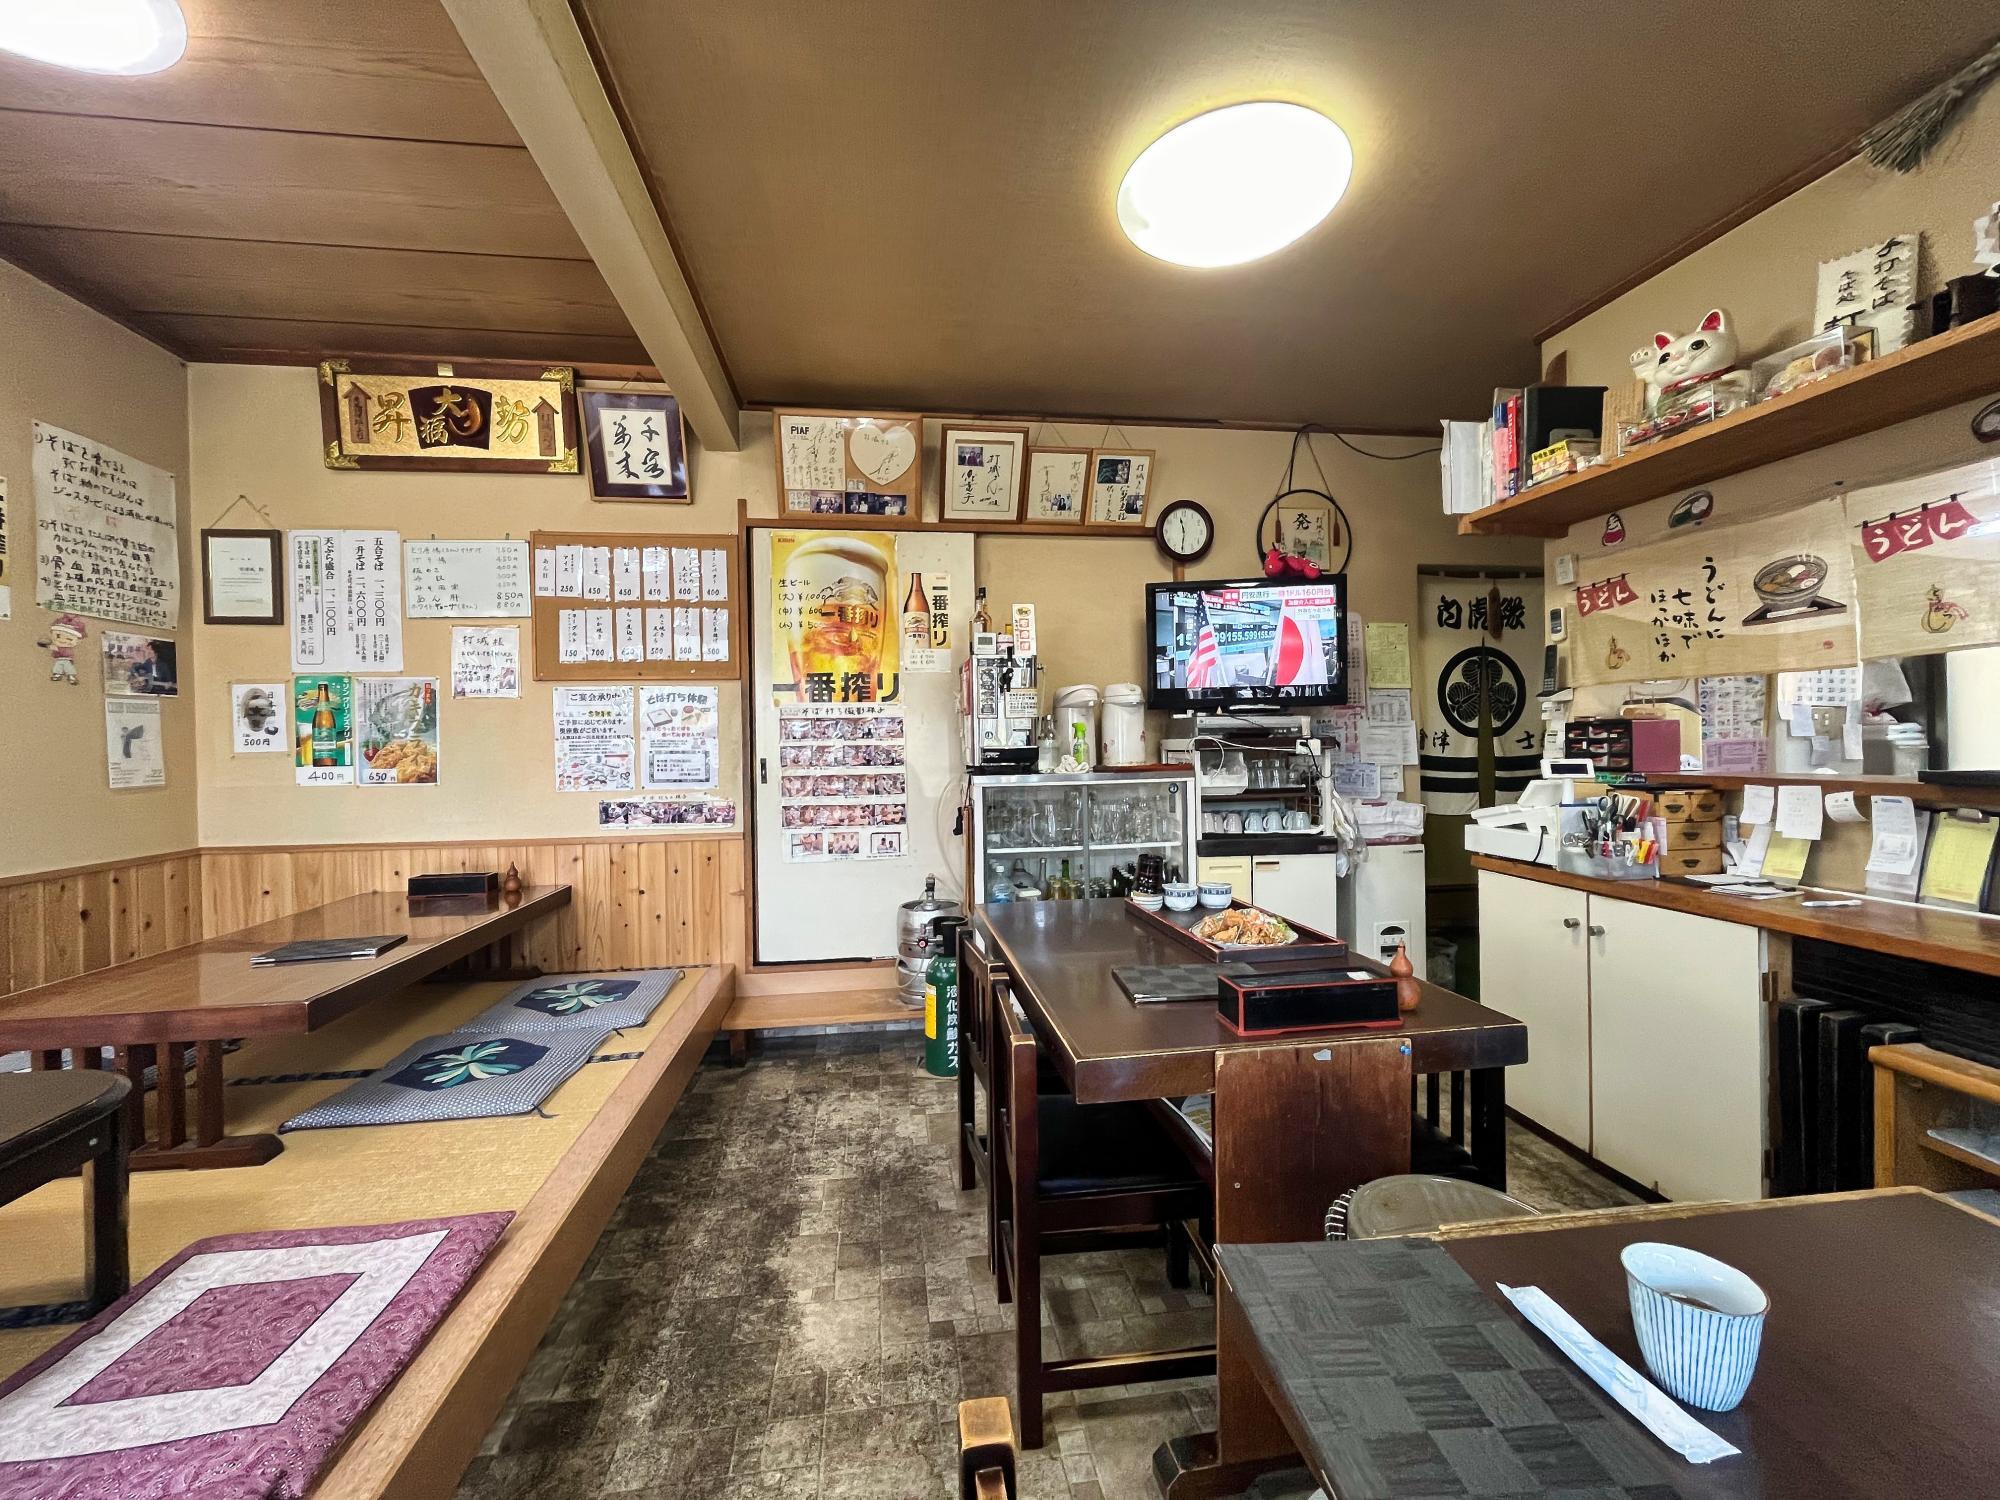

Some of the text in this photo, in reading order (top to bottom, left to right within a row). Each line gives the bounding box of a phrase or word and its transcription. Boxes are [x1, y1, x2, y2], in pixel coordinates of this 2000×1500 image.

[1871, 237, 1904, 310] 手打そば
[790, 425, 810, 435] PIAF
[1293, 512, 1312, 531] 発
[1870, 513, 1968, 556] うどん
[324, 537, 335, 580] 天ぷら盛合
[355, 540, 366, 571] 一升そば
[373, 537, 385, 571] 五合そば
[560, 585, 574, 593] 250
[588, 587, 601, 595] 450
[618, 588, 632, 596] 450
[648, 588, 662, 596] 450
[706, 588, 720, 596] 400
[777, 578, 811, 588] 生ビール
[1579, 584, 1630, 613] うどん
[1701, 556, 1728, 640] うどんに
[820, 606, 879, 629] 一番搾り
[931, 585, 949, 647] 一番搾り
[1672, 586, 1704, 650] 七味で
[564, 649, 578, 657] 150
[772, 671, 900, 703] 一番搾り
[243, 738, 271, 746] 500円
[308, 771, 344, 781] 400円
[368, 772, 396, 782] 650円
